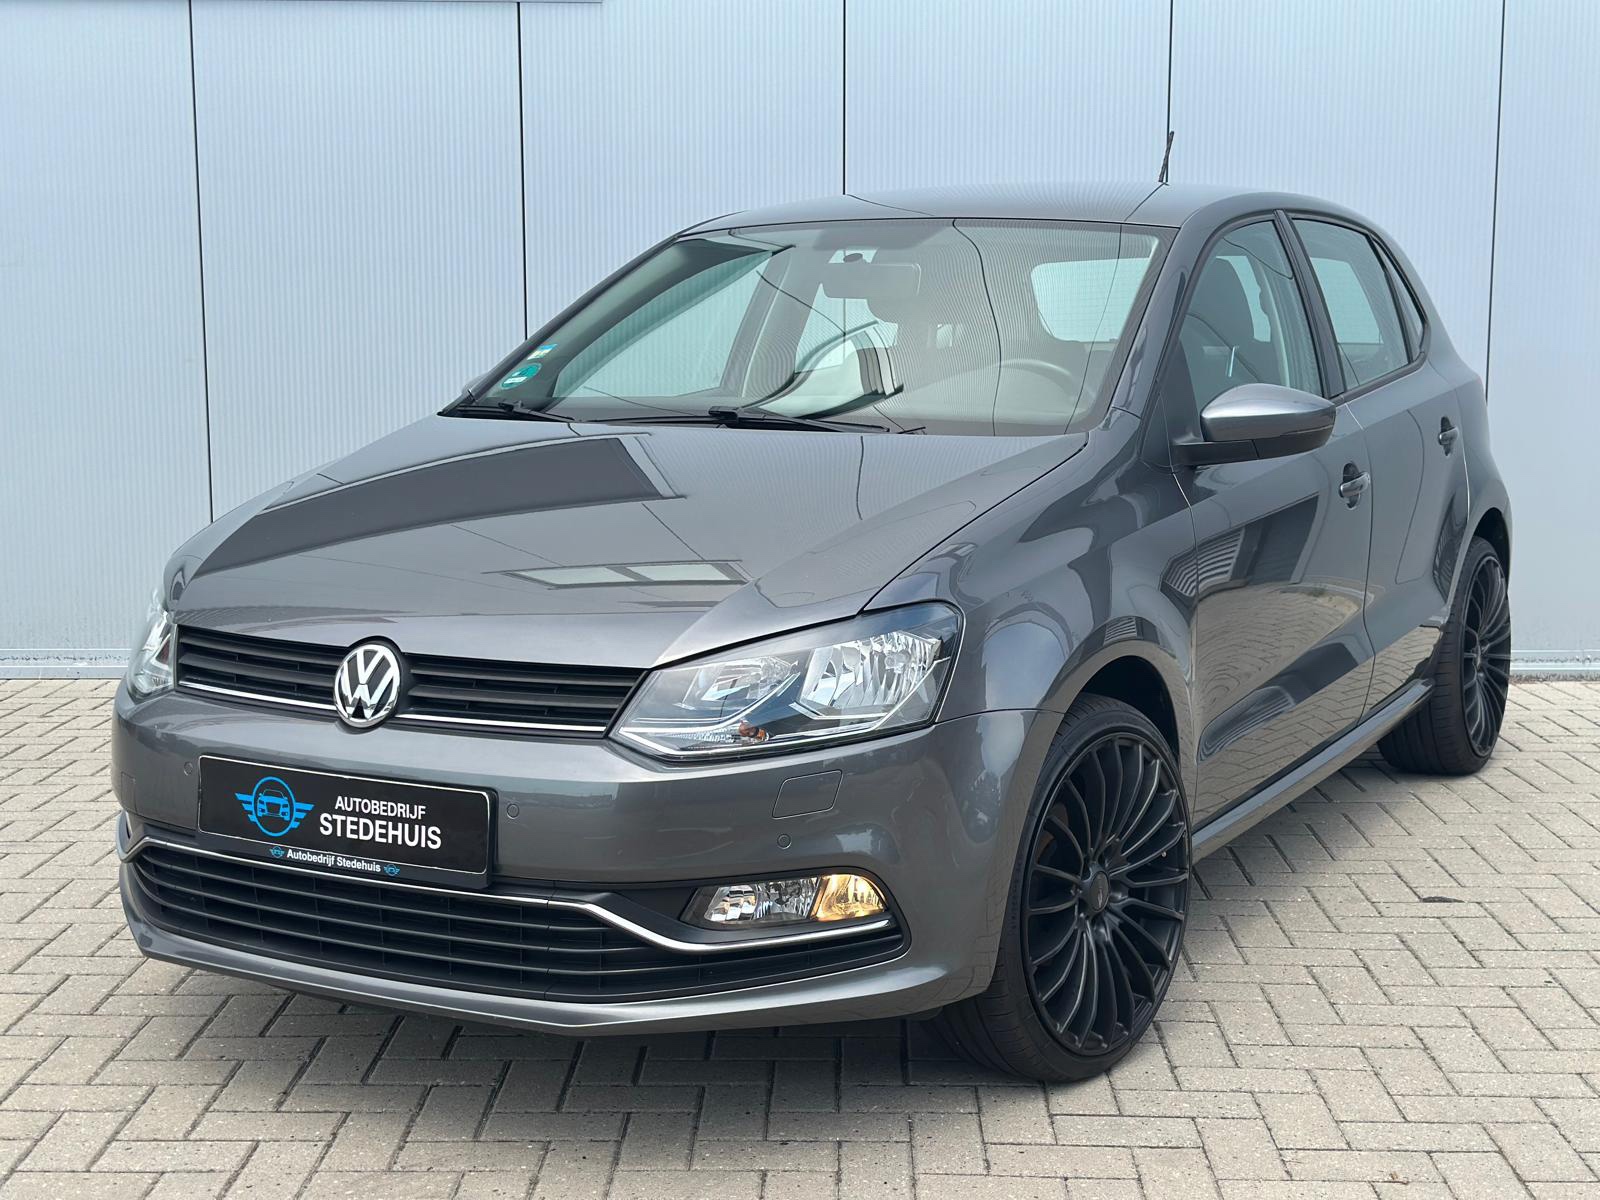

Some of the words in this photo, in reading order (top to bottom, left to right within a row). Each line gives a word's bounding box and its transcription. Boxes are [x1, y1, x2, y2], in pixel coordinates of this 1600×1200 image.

[335, 644, 400, 727] VW
[335, 796, 426, 819] AUTOBEDRIJF
[320, 812, 441, 849] STEDEHUIS
[287, 849, 335, 867] Autobedrijf
[337, 857, 380, 872] Stedehuis
